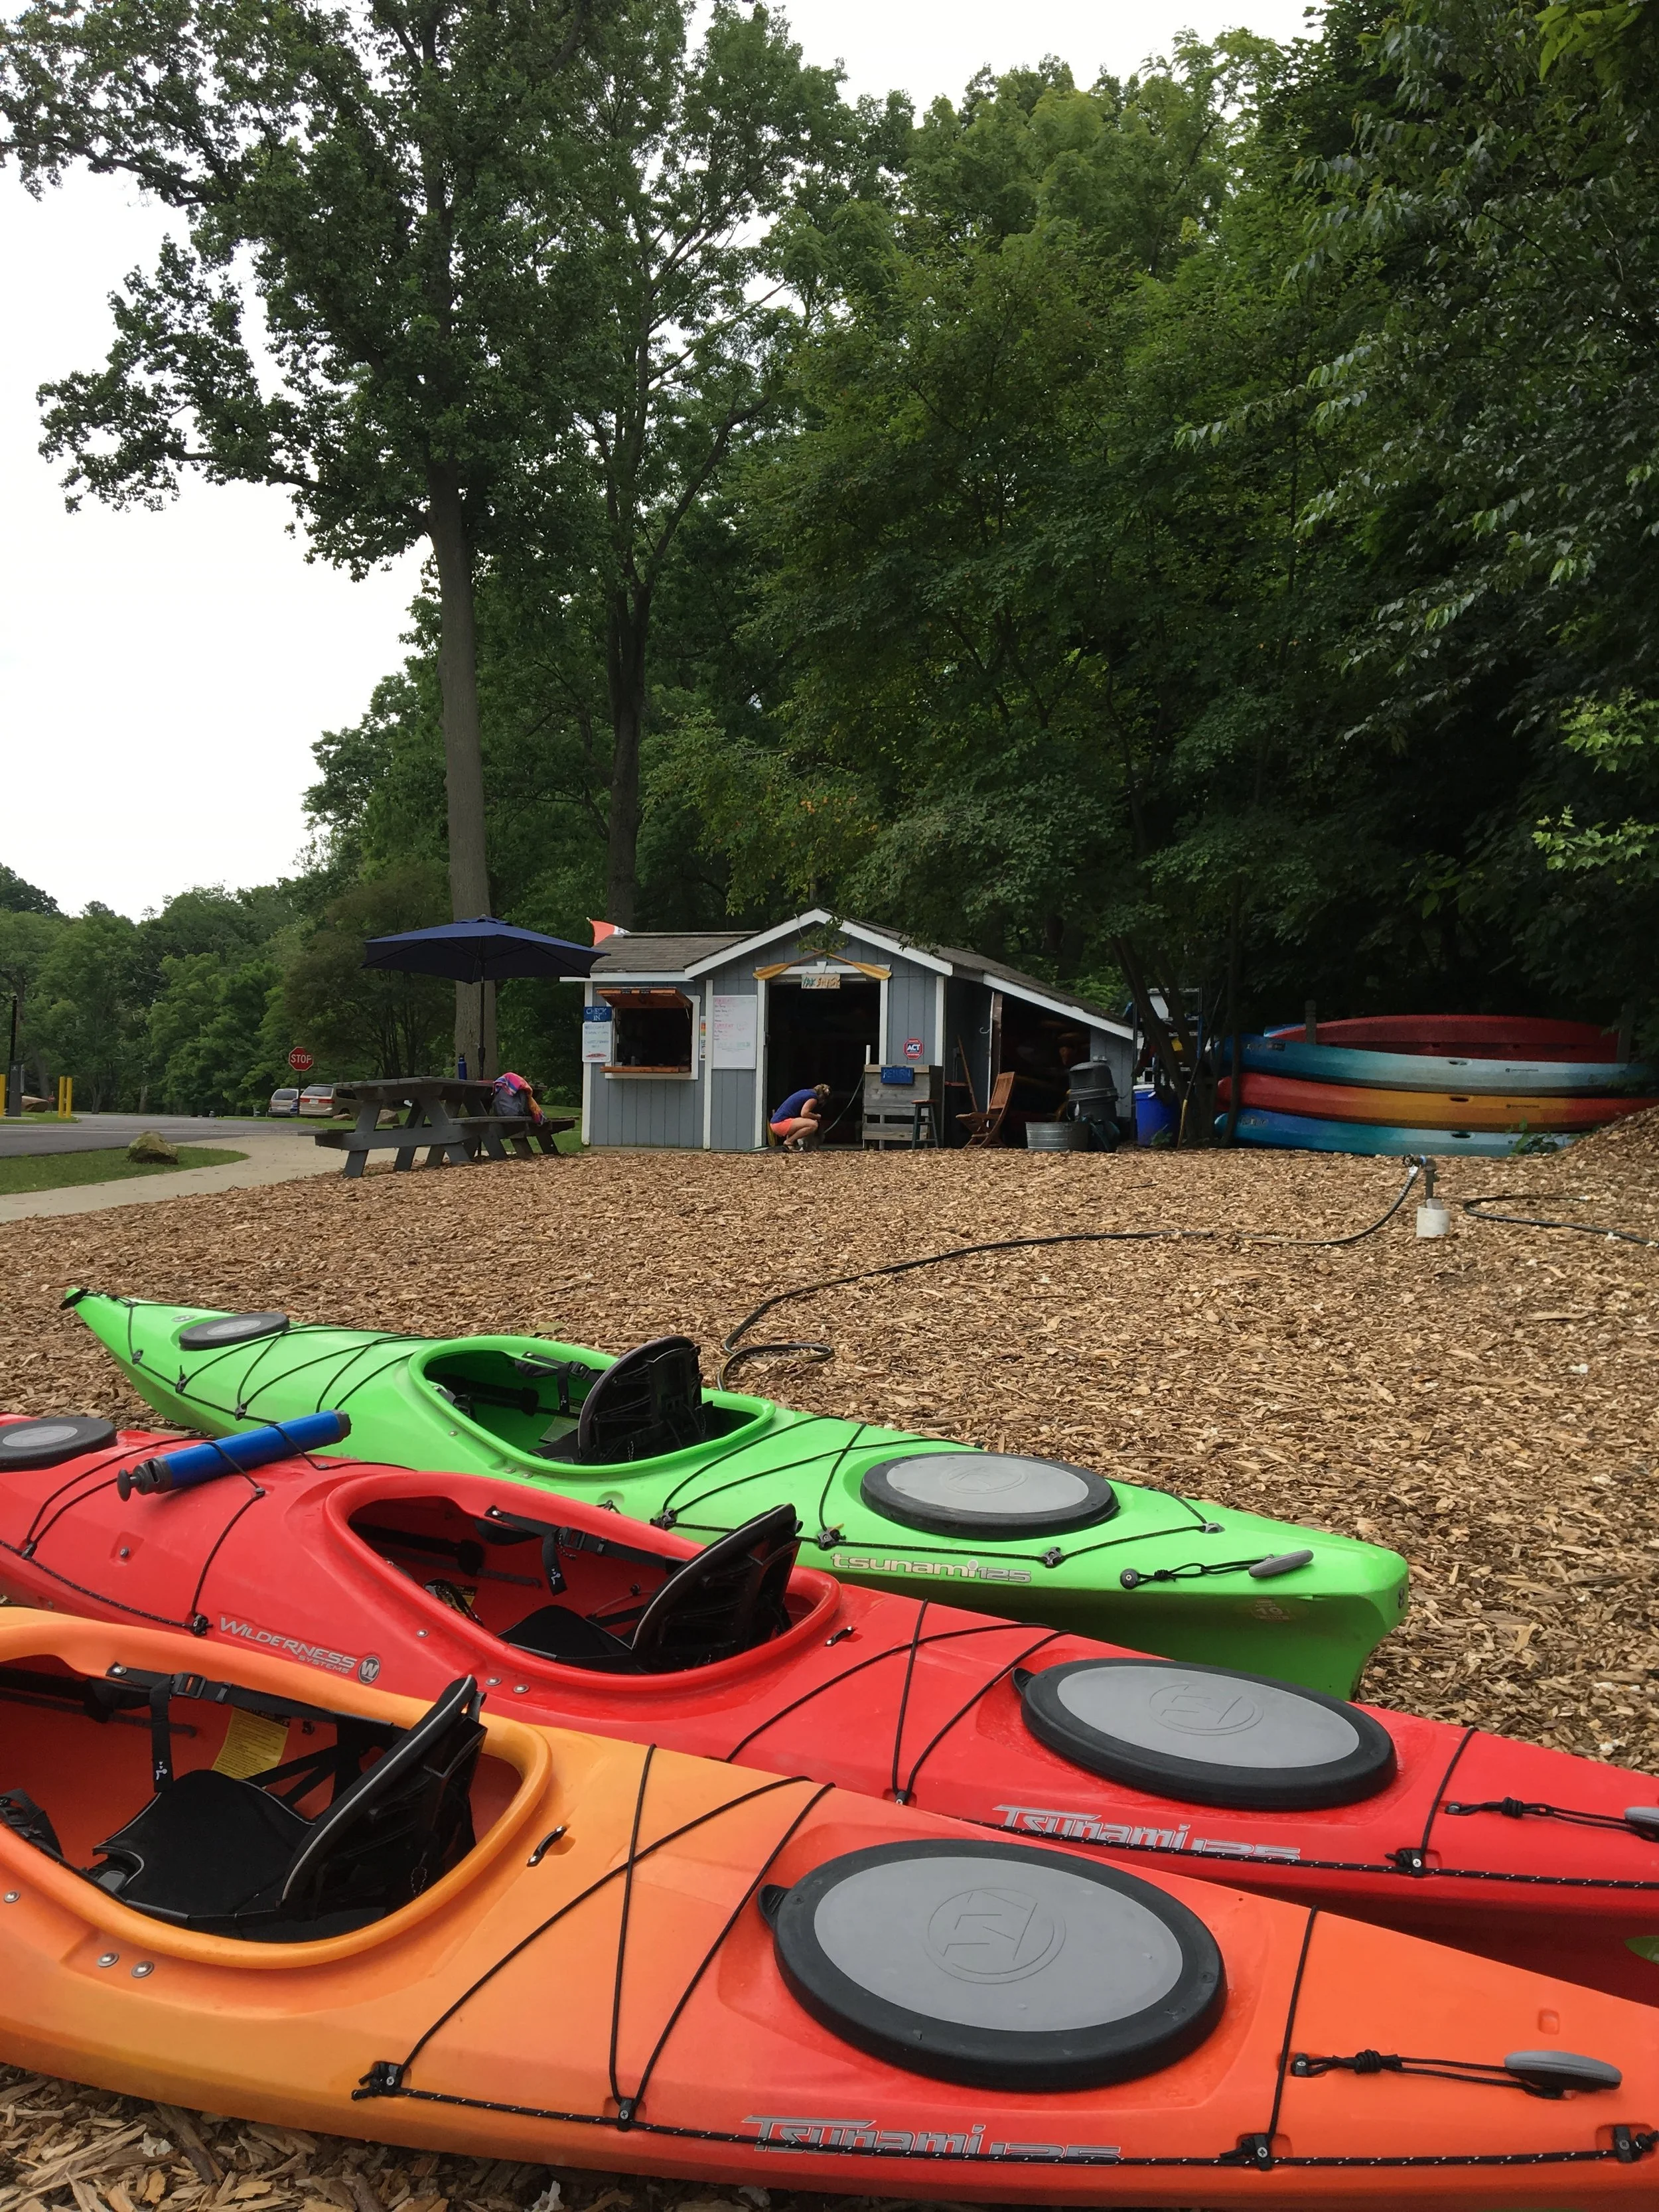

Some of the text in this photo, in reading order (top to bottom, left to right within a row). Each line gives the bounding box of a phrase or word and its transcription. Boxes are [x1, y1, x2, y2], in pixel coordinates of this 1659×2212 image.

[291, 1054, 312, 1064] STOP
[883, 1069, 910, 1078] RETURN
[831, 1553, 1031, 1583] tsunami 125
[220, 1617, 358, 1669] WILDERNESS
[297, 1655, 351, 1674] SYSTEMS
[992, 1804, 1301, 1860] Tsunami 125
[742, 2114, 986, 2160] Tsunami
